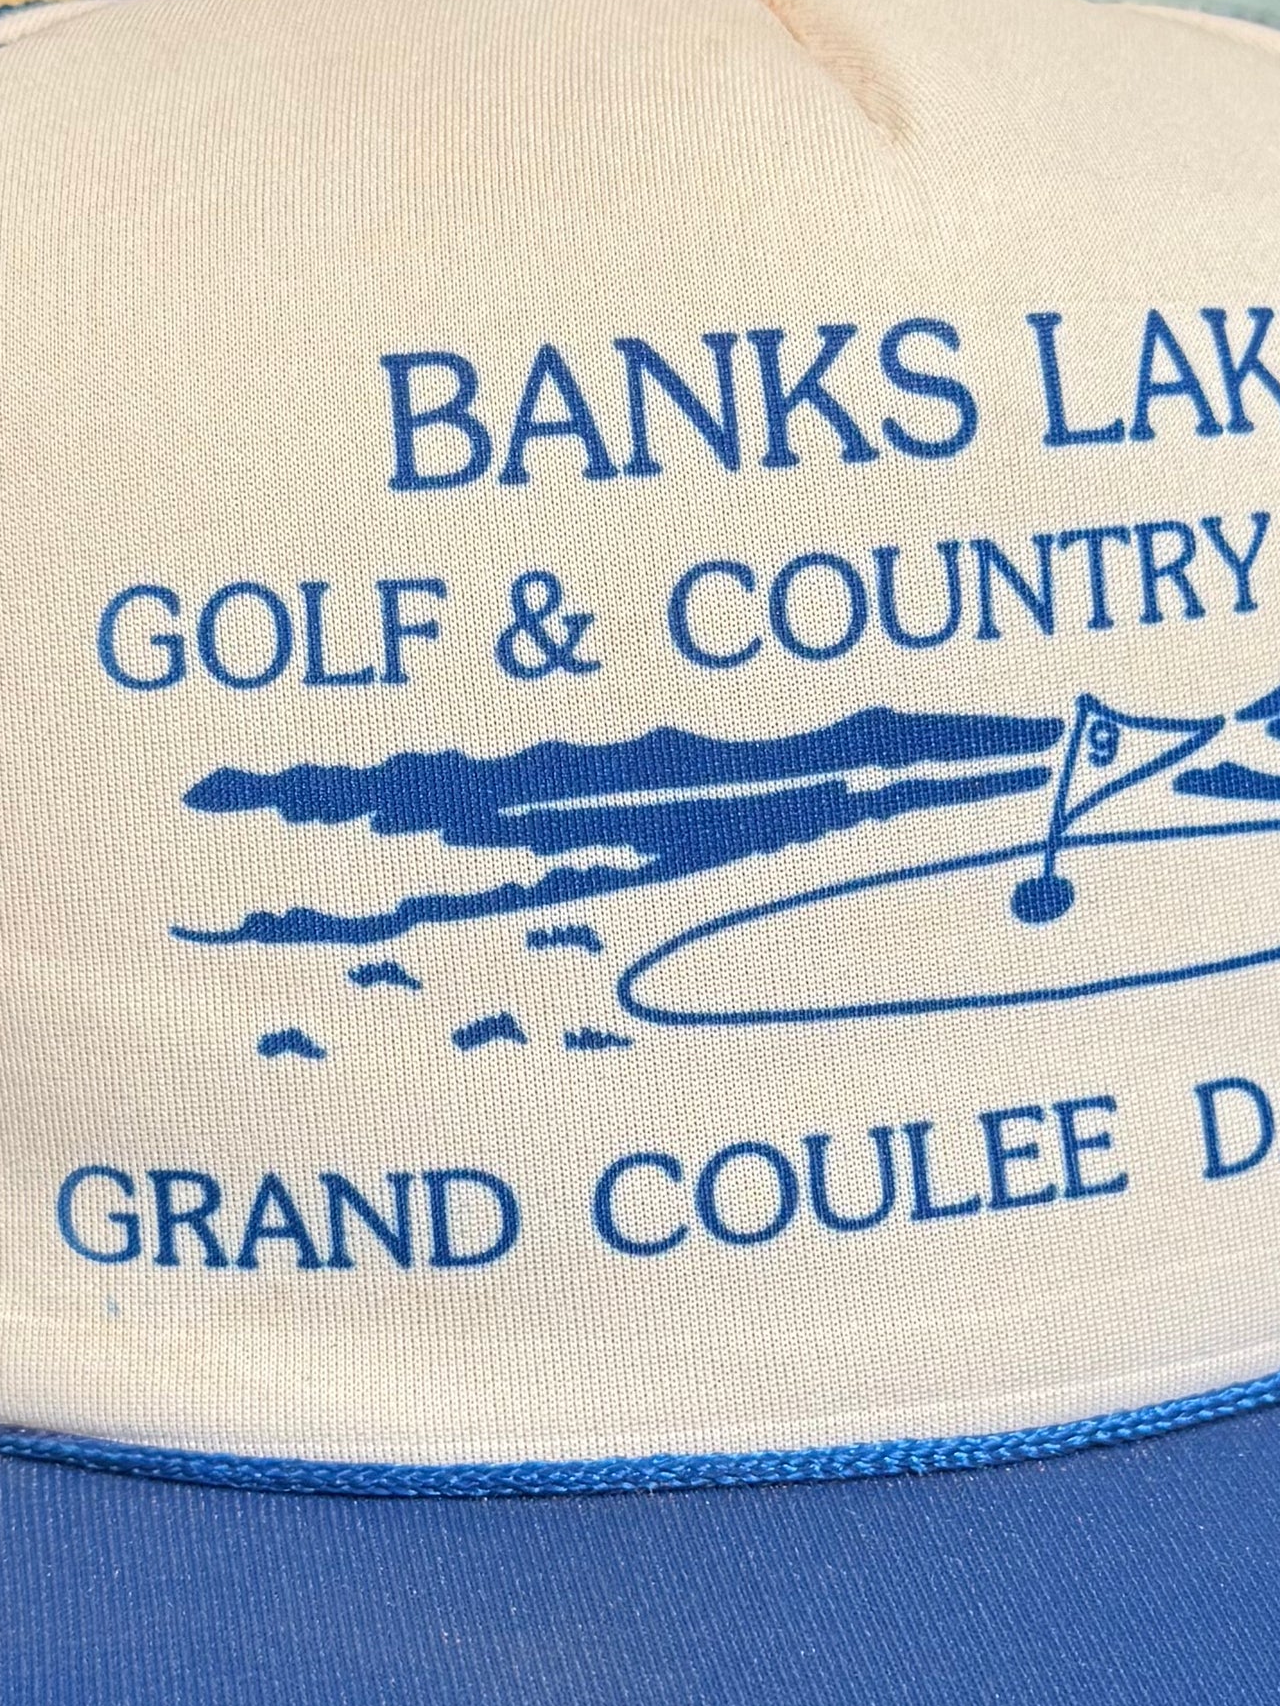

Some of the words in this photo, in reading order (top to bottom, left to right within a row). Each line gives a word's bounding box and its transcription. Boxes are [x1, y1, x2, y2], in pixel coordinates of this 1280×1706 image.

[381, 319, 977, 492] BANKS
[98, 579, 445, 691] GOLF
[495, 571, 599, 680] &
[668, 512, 1269, 669] COUNTRY
[1089, 720, 1120, 767] 9
[57, 1166, 520, 1271] GRAND
[592, 1097, 1126, 1256] COULEE
